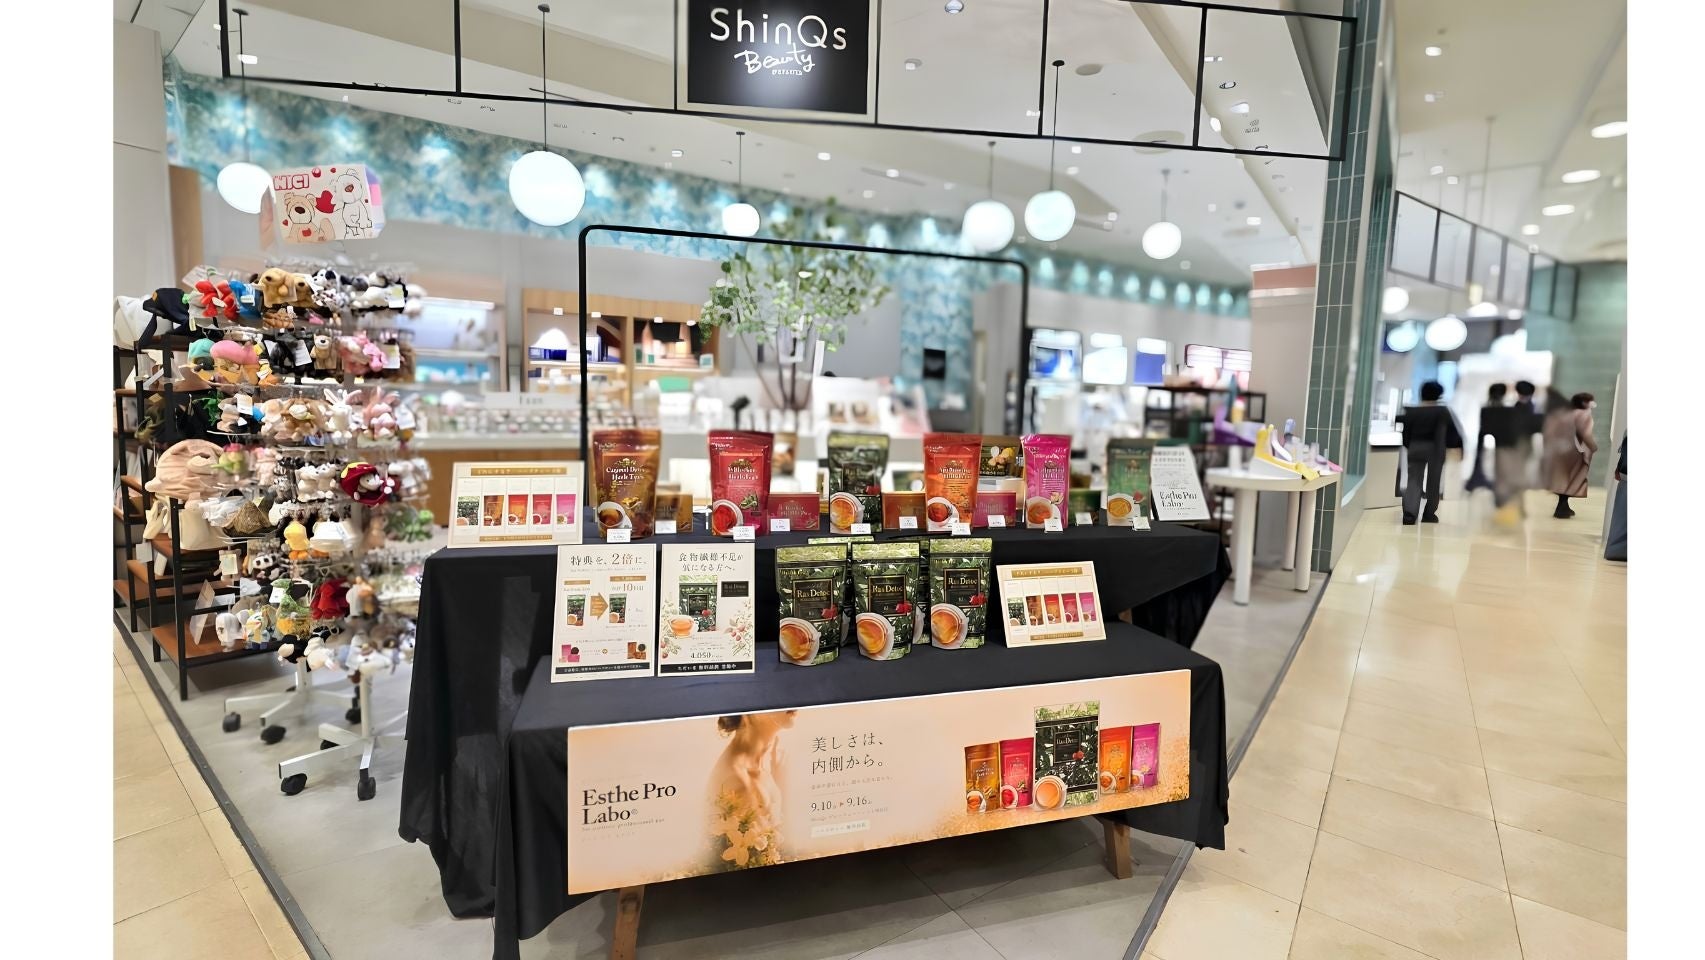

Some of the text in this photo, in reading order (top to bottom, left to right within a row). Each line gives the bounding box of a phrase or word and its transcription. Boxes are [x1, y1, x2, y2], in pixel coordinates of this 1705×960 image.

[710, 7, 847, 50] ShinQs
[733, 42, 816, 74] Beauty
[273, 174, 309, 191] NICI
[812, 732, 883, 753] 美しさは、
[812, 753, 883, 775] 内側から。
[582, 782, 677, 807] Esthe Pro
